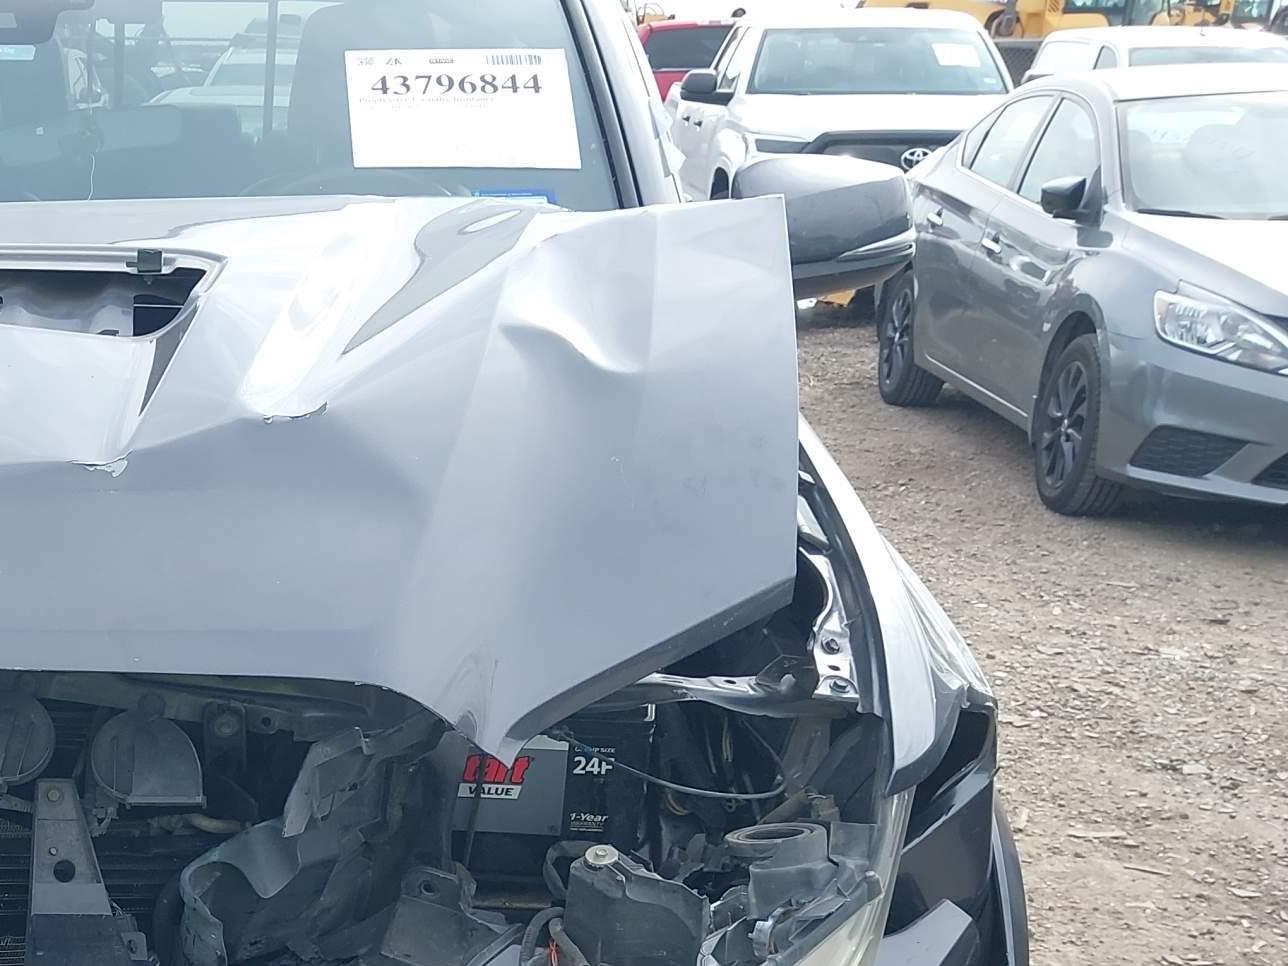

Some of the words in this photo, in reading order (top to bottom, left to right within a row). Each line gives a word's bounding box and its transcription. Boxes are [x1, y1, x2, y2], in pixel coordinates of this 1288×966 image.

[370, 73, 543, 96] 43796844
[468, 786, 514, 797] VALUE
[569, 812, 609, 822] 1-Year
